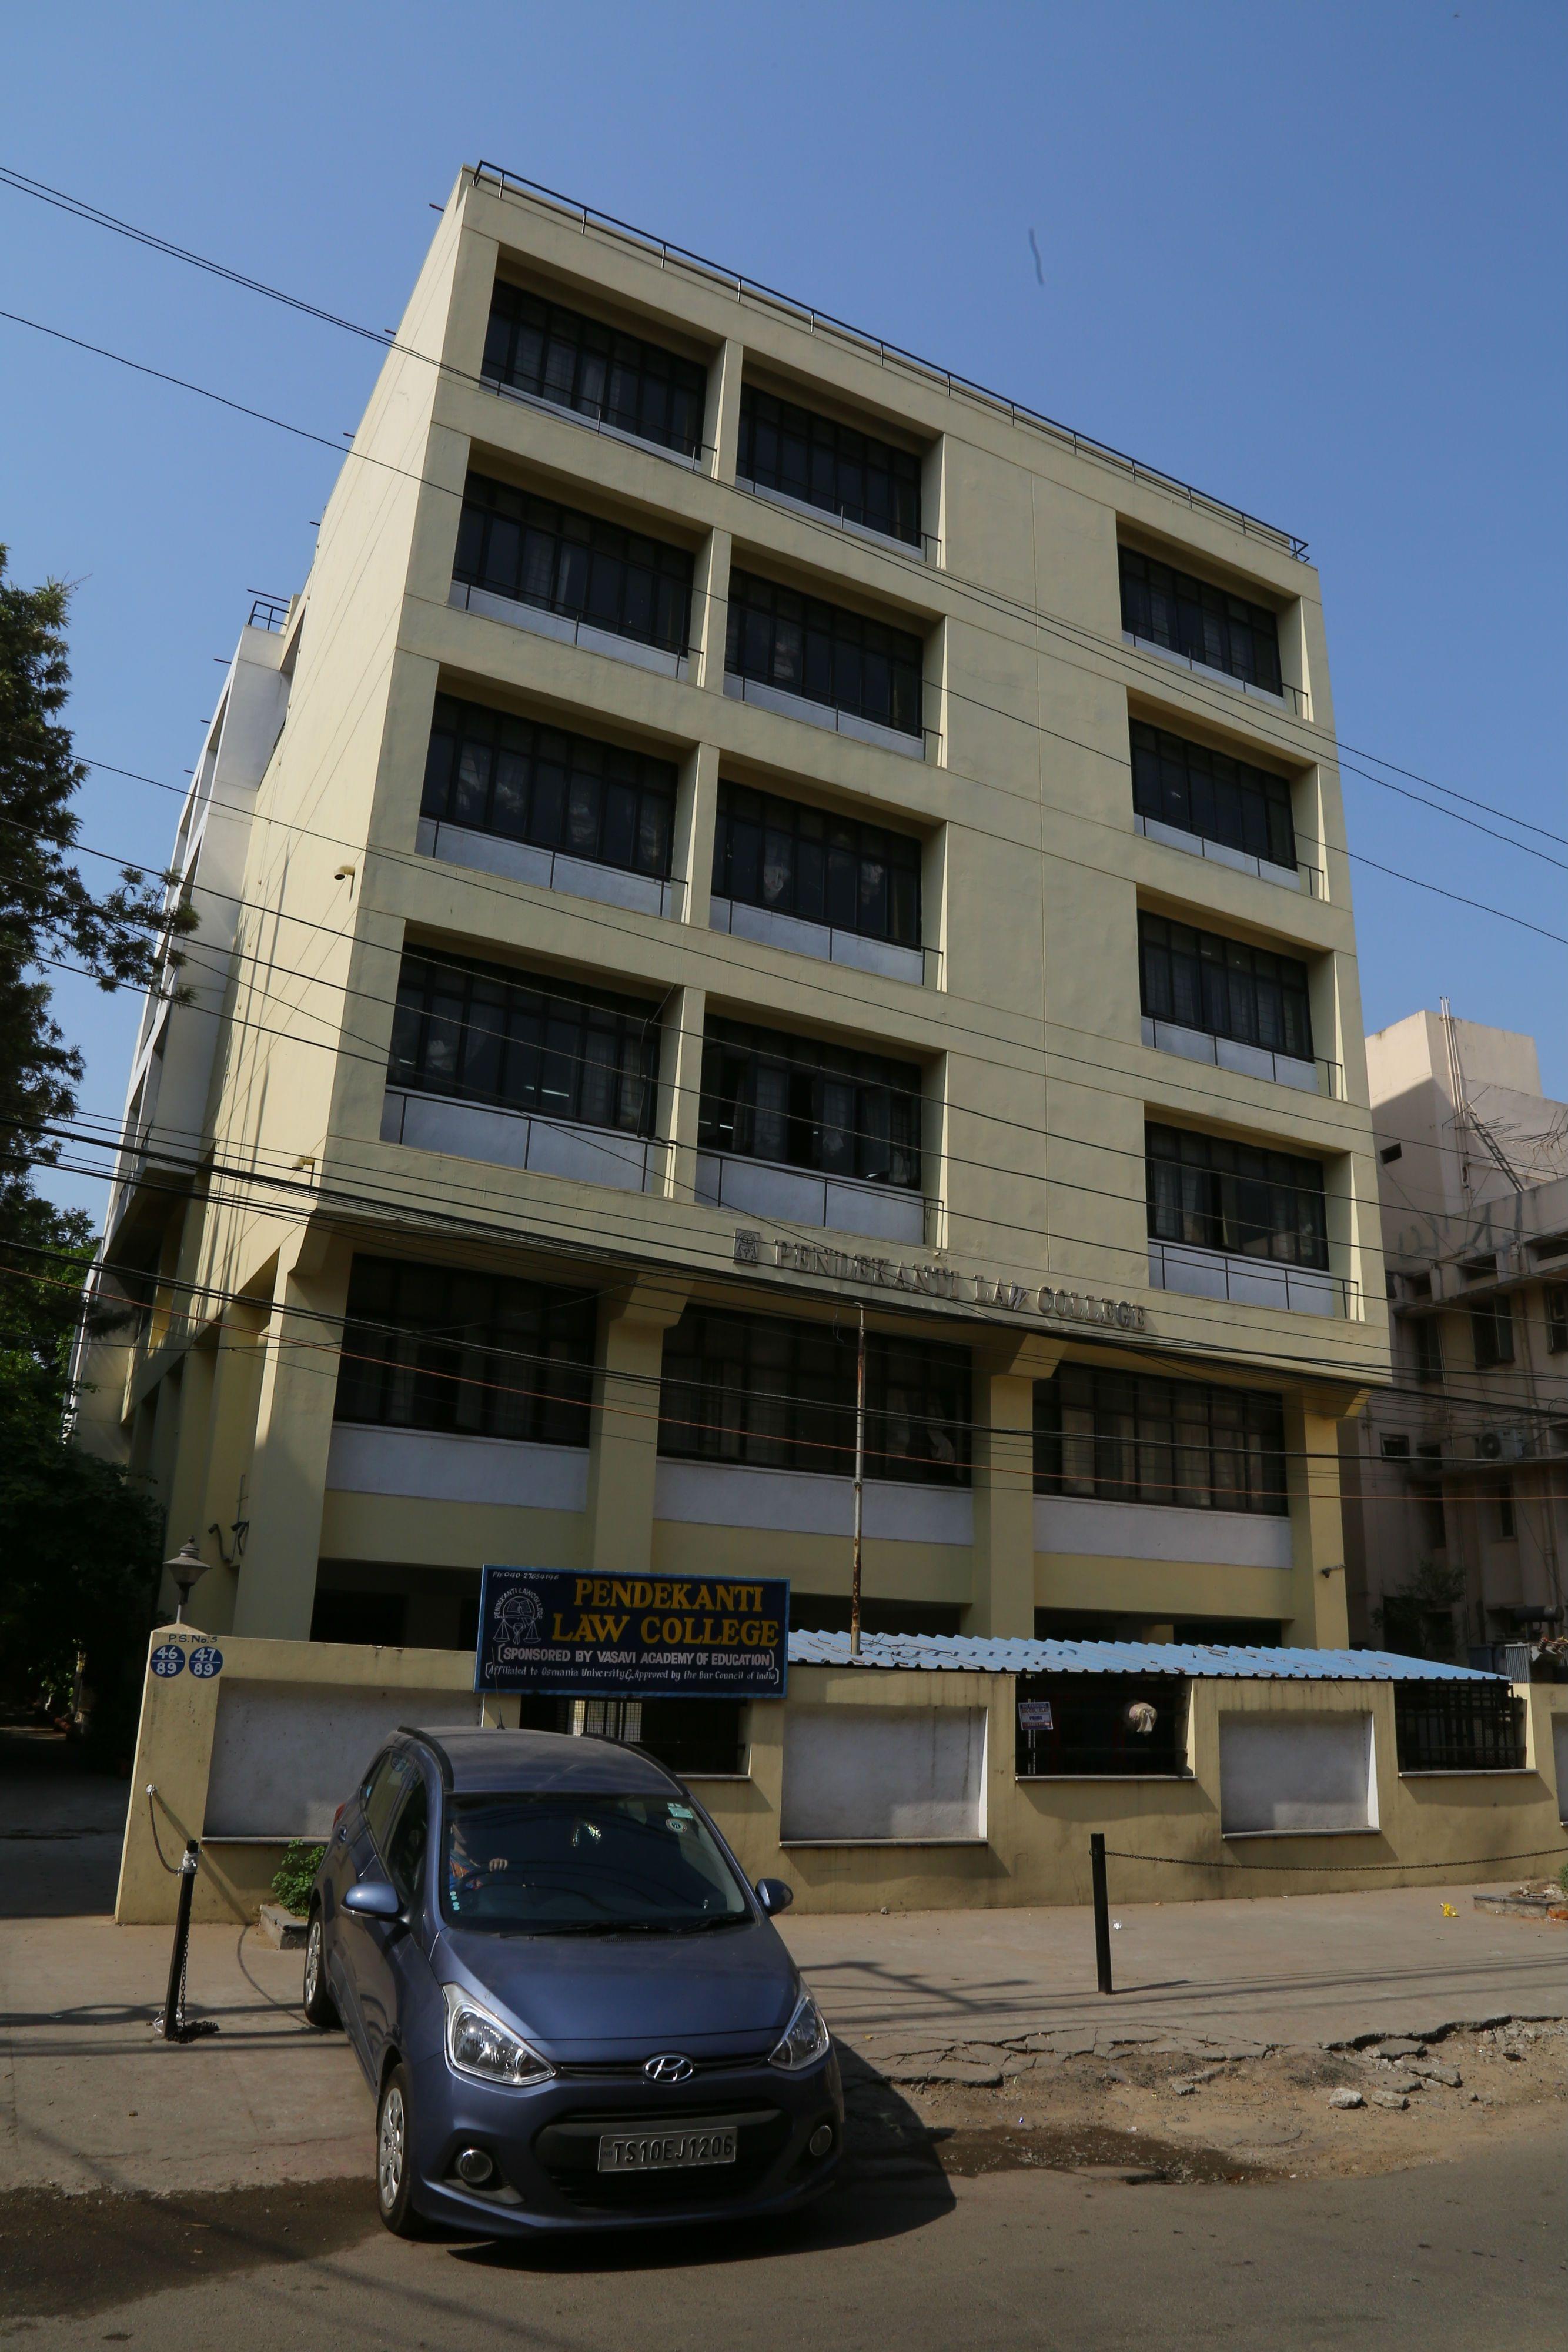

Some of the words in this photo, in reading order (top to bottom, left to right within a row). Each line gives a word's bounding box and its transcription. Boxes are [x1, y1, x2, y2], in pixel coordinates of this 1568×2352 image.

[774, 1239, 959, 1298] PENDEKANTI
[974, 1274, 1029, 1312] LAW
[1037, 1285, 1146, 1331] COLLEGE
[574, 1578, 764, 1612] PENDEKANTI
[551, 1613, 630, 1643] LAW
[641, 1616, 780, 1648] COLLEGE
[156, 1646, 178, 1659] 46
[195, 1648, 216, 1661] 47
[576, 1651, 593, 1663] BY
[597, 1651, 636, 1664] VASAVI
[640, 1652, 694, 1665] ACADEMY
[696, 1652, 710, 1665] OF
[156, 1662, 177, 1675] 89
[193, 1663, 214, 1676] 89
[530, 1666, 538, 1675] to
[541, 1667, 579, 1677] Osmania
[581, 1667, 625, 1680] University
[671, 1670, 681, 1682] by
[684, 1670, 697, 1681] the
[699, 1671, 714, 1681] Bar
[714, 1671, 744, 1681] Council
[747, 1671, 754, 1681] of
[613, 2135, 733, 2164] TS10EJ1206
